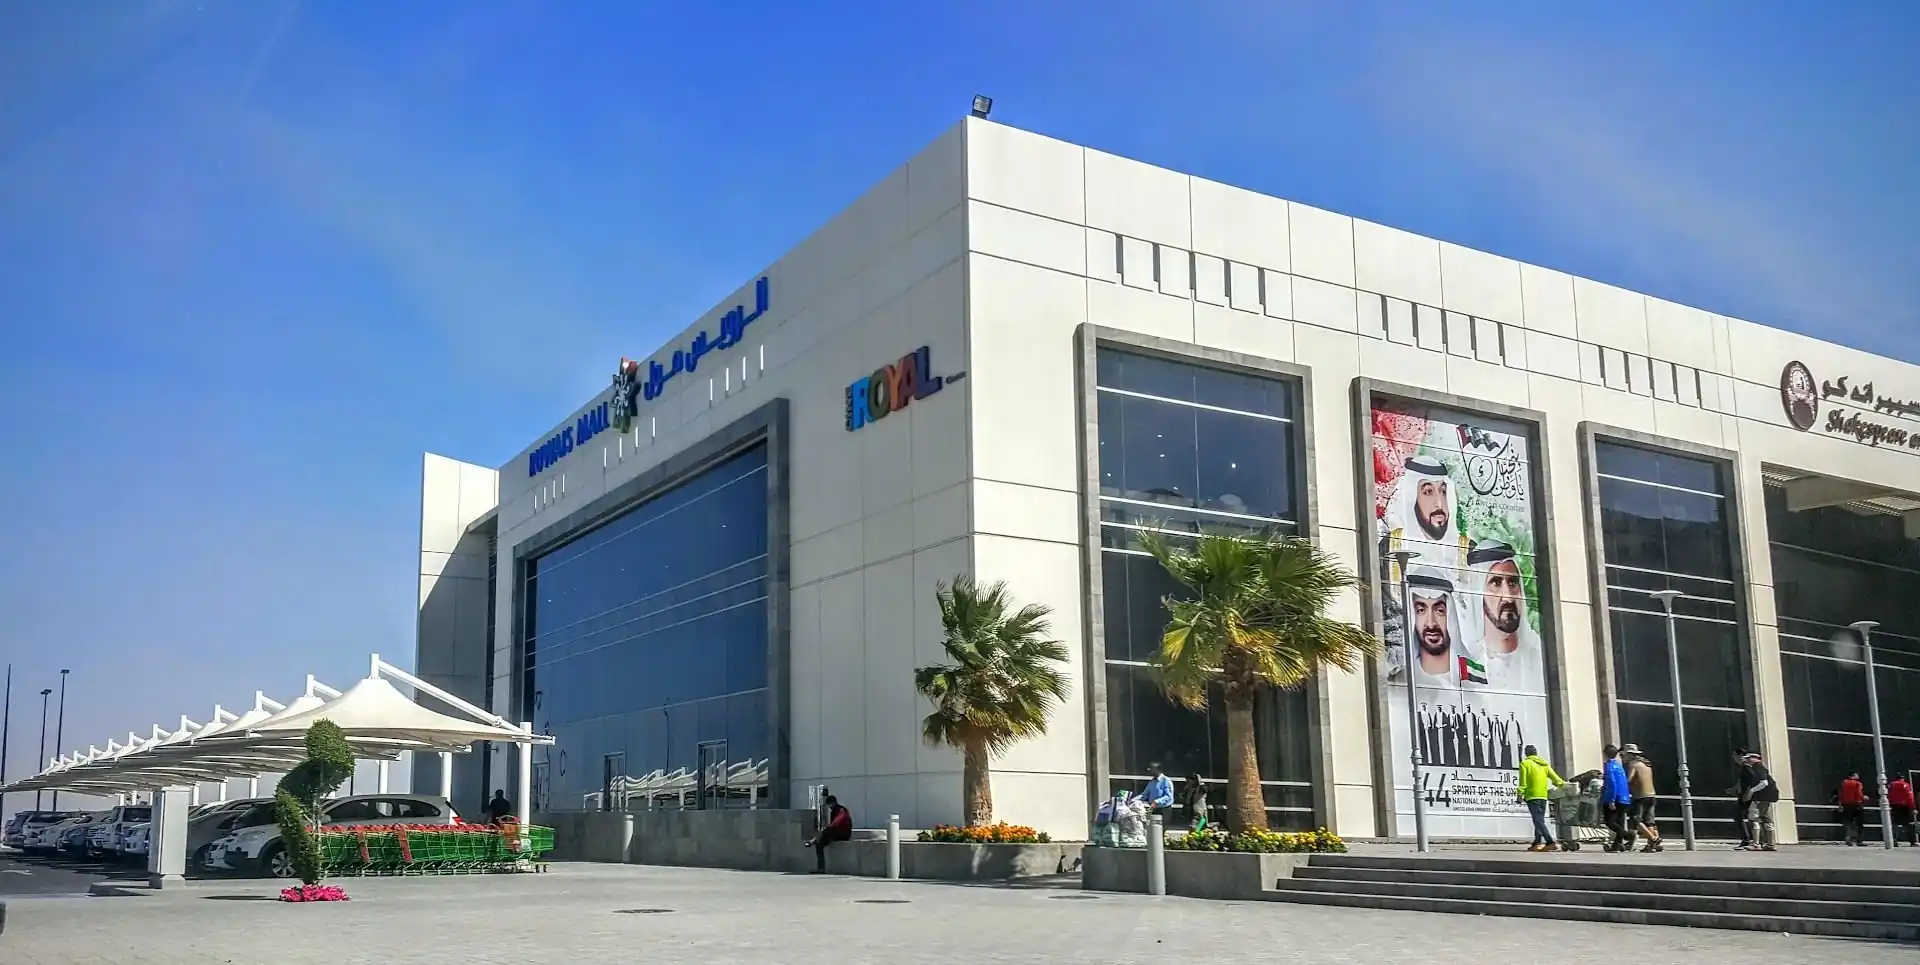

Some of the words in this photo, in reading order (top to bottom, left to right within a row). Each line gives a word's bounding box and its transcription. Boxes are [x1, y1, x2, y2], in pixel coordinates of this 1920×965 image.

[686, 277, 768, 372] الرويس
[644, 350, 684, 401] مول
[853, 345, 943, 431] ROYAL
[576, 401, 611, 446] MALL
[1825, 408, 1908, 446] Shakespeare
[1423, 773, 1451, 807] 44
[1452, 785, 1476, 795] SPIRIT
[1478, 786, 1489, 796] OF
[1489, 786, 1504, 796] THE
[1452, 797, 1479, 805] NATIONAL
[1480, 797, 1491, 805] DAY
